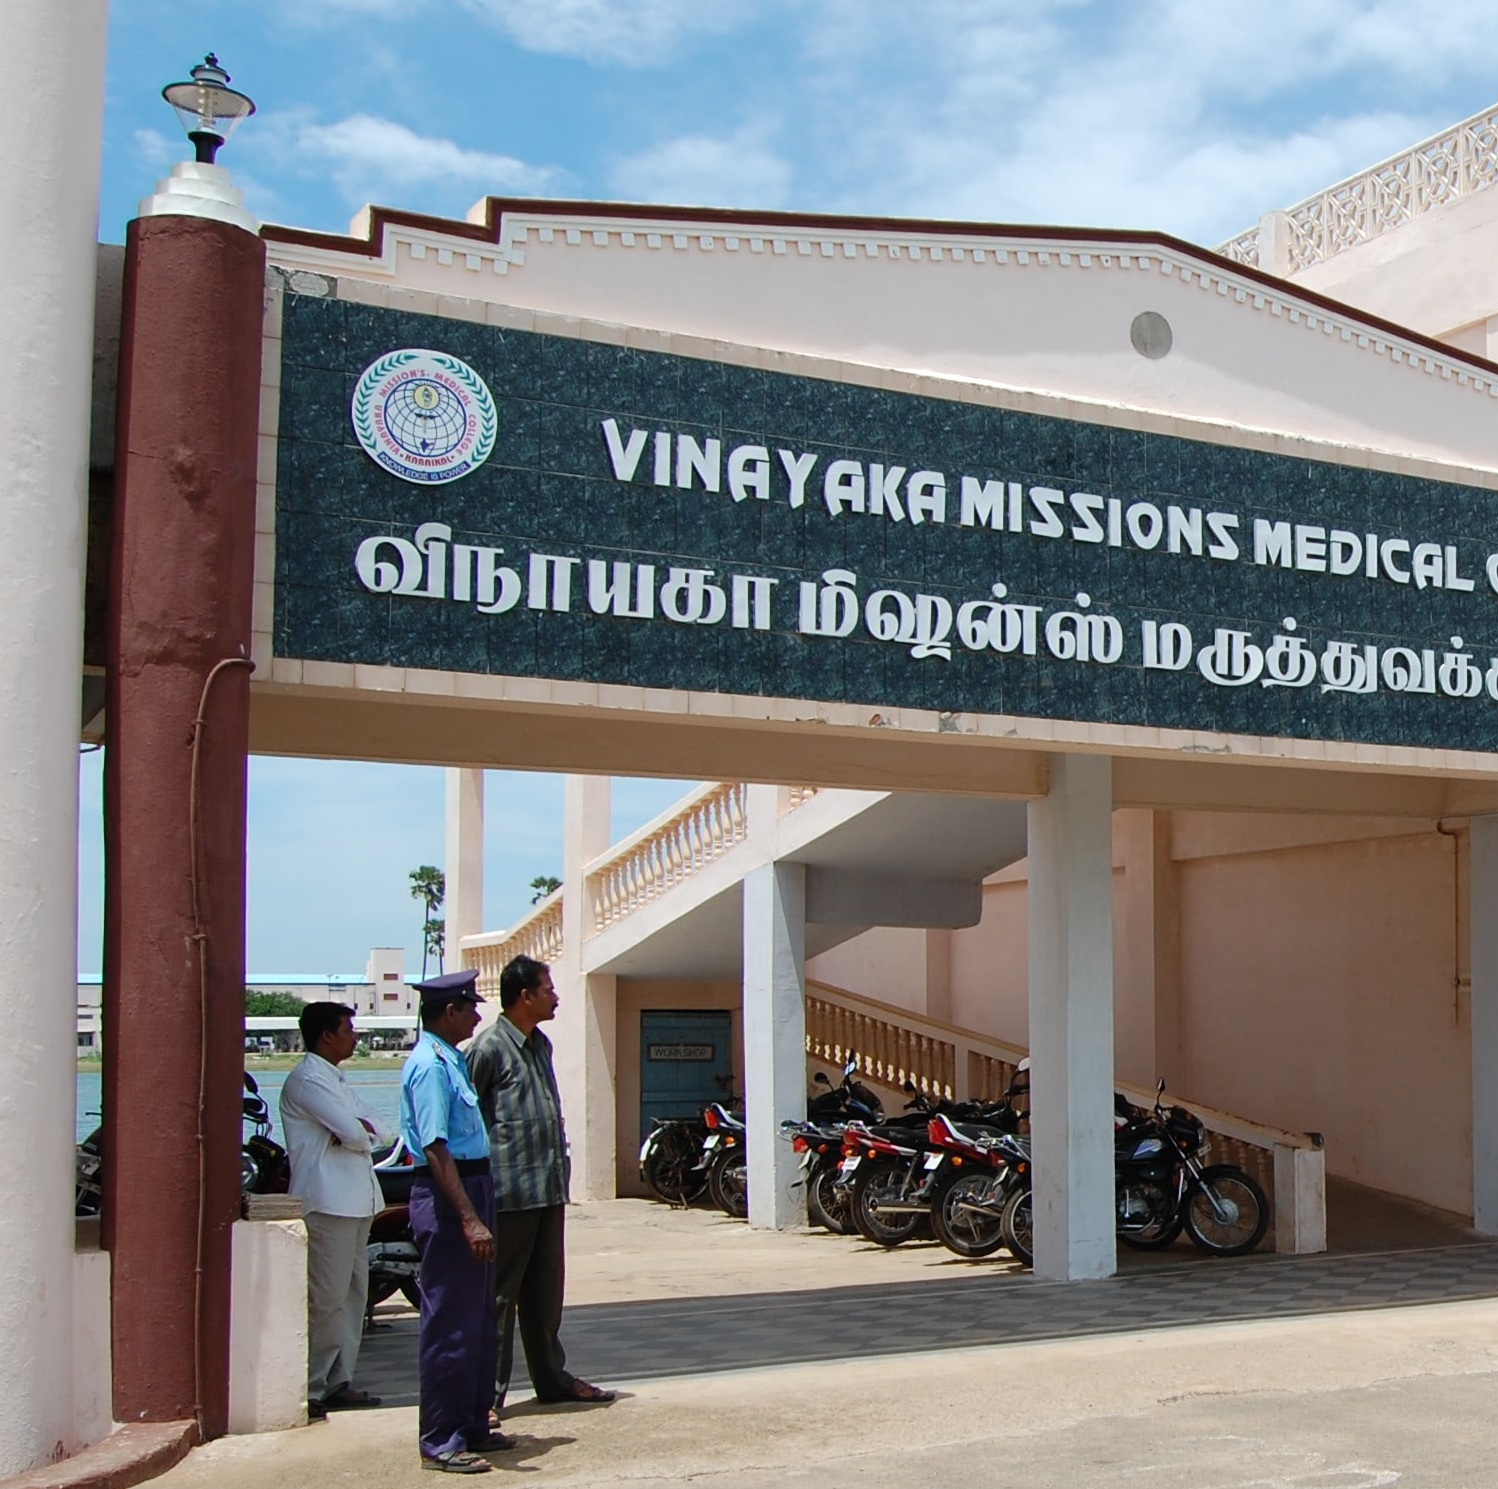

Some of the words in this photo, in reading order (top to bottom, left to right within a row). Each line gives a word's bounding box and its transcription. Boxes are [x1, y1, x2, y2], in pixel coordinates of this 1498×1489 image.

[379, 454, 429, 480] KNOWLEDGE
[440, 463, 469, 480] POWER
[434, 373, 472, 407] MEDICAL
[458, 415, 477, 456] COLLEGE
[602, 419, 947, 525] VINAYAKA
[961, 477, 1240, 560] MISSIONS
[1254, 519, 1475, 592] MEDICAL
[356, 523, 780, 637] விநாயகா
[799, 569, 1123, 663] மிஷன்ஸ்
